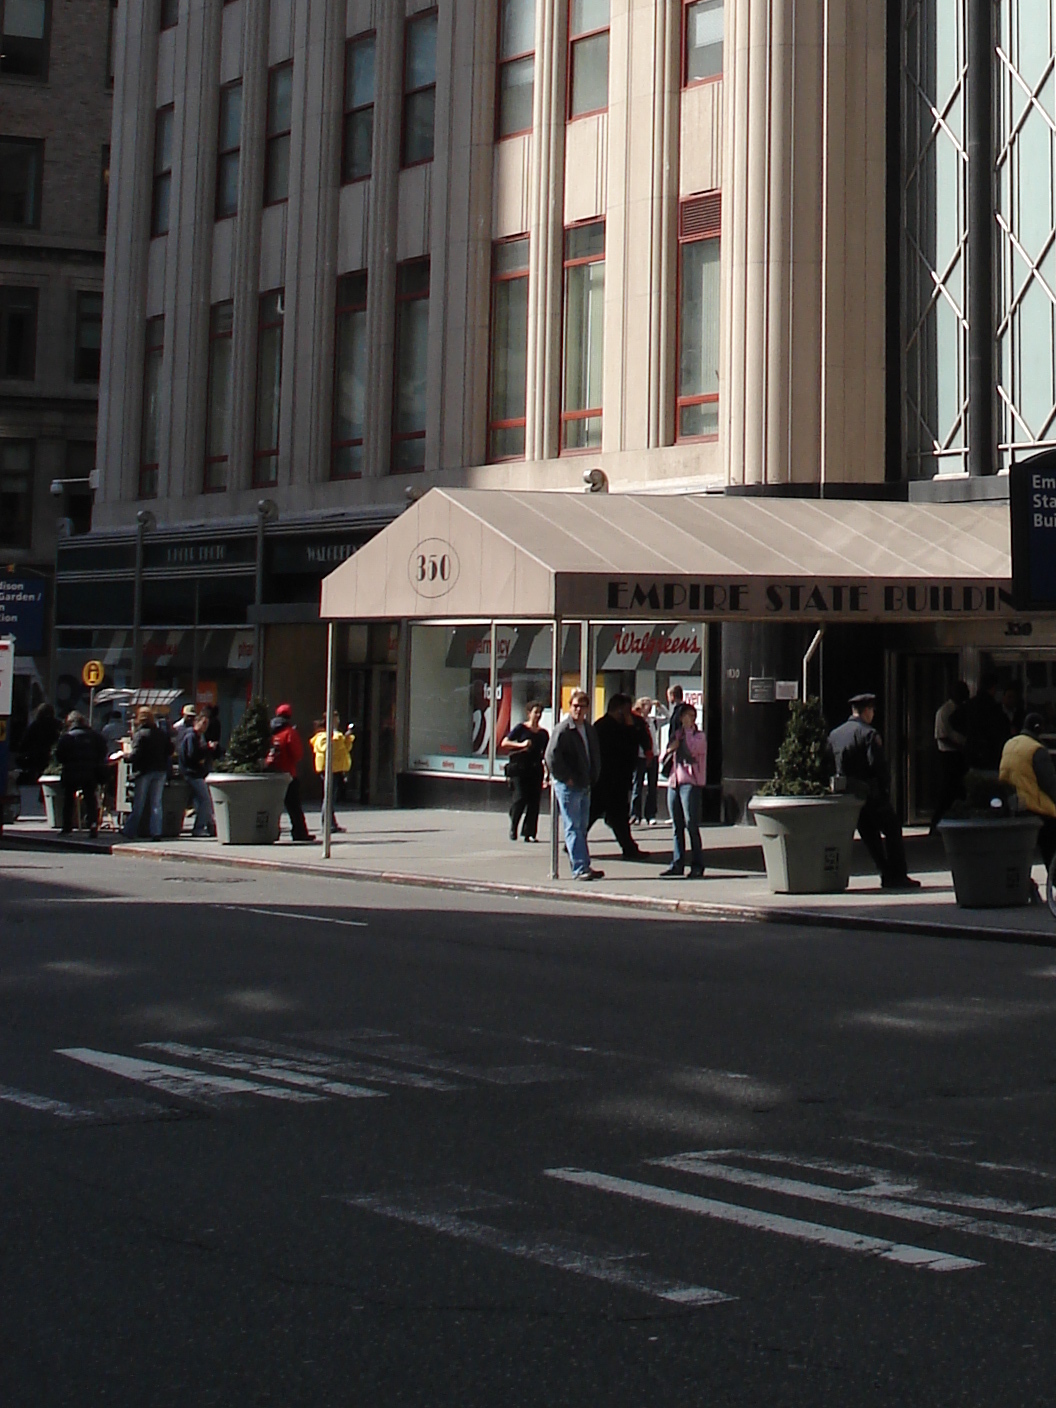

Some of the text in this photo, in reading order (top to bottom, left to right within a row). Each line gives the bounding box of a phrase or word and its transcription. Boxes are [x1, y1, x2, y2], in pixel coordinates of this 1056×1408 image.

[416, 554, 451, 582] 350
[607, 581, 1018, 612] EMPIRE STATE BUILDIN
[613, 630, 702, 662] Walgreens
[483, 682, 503, 700] fod
